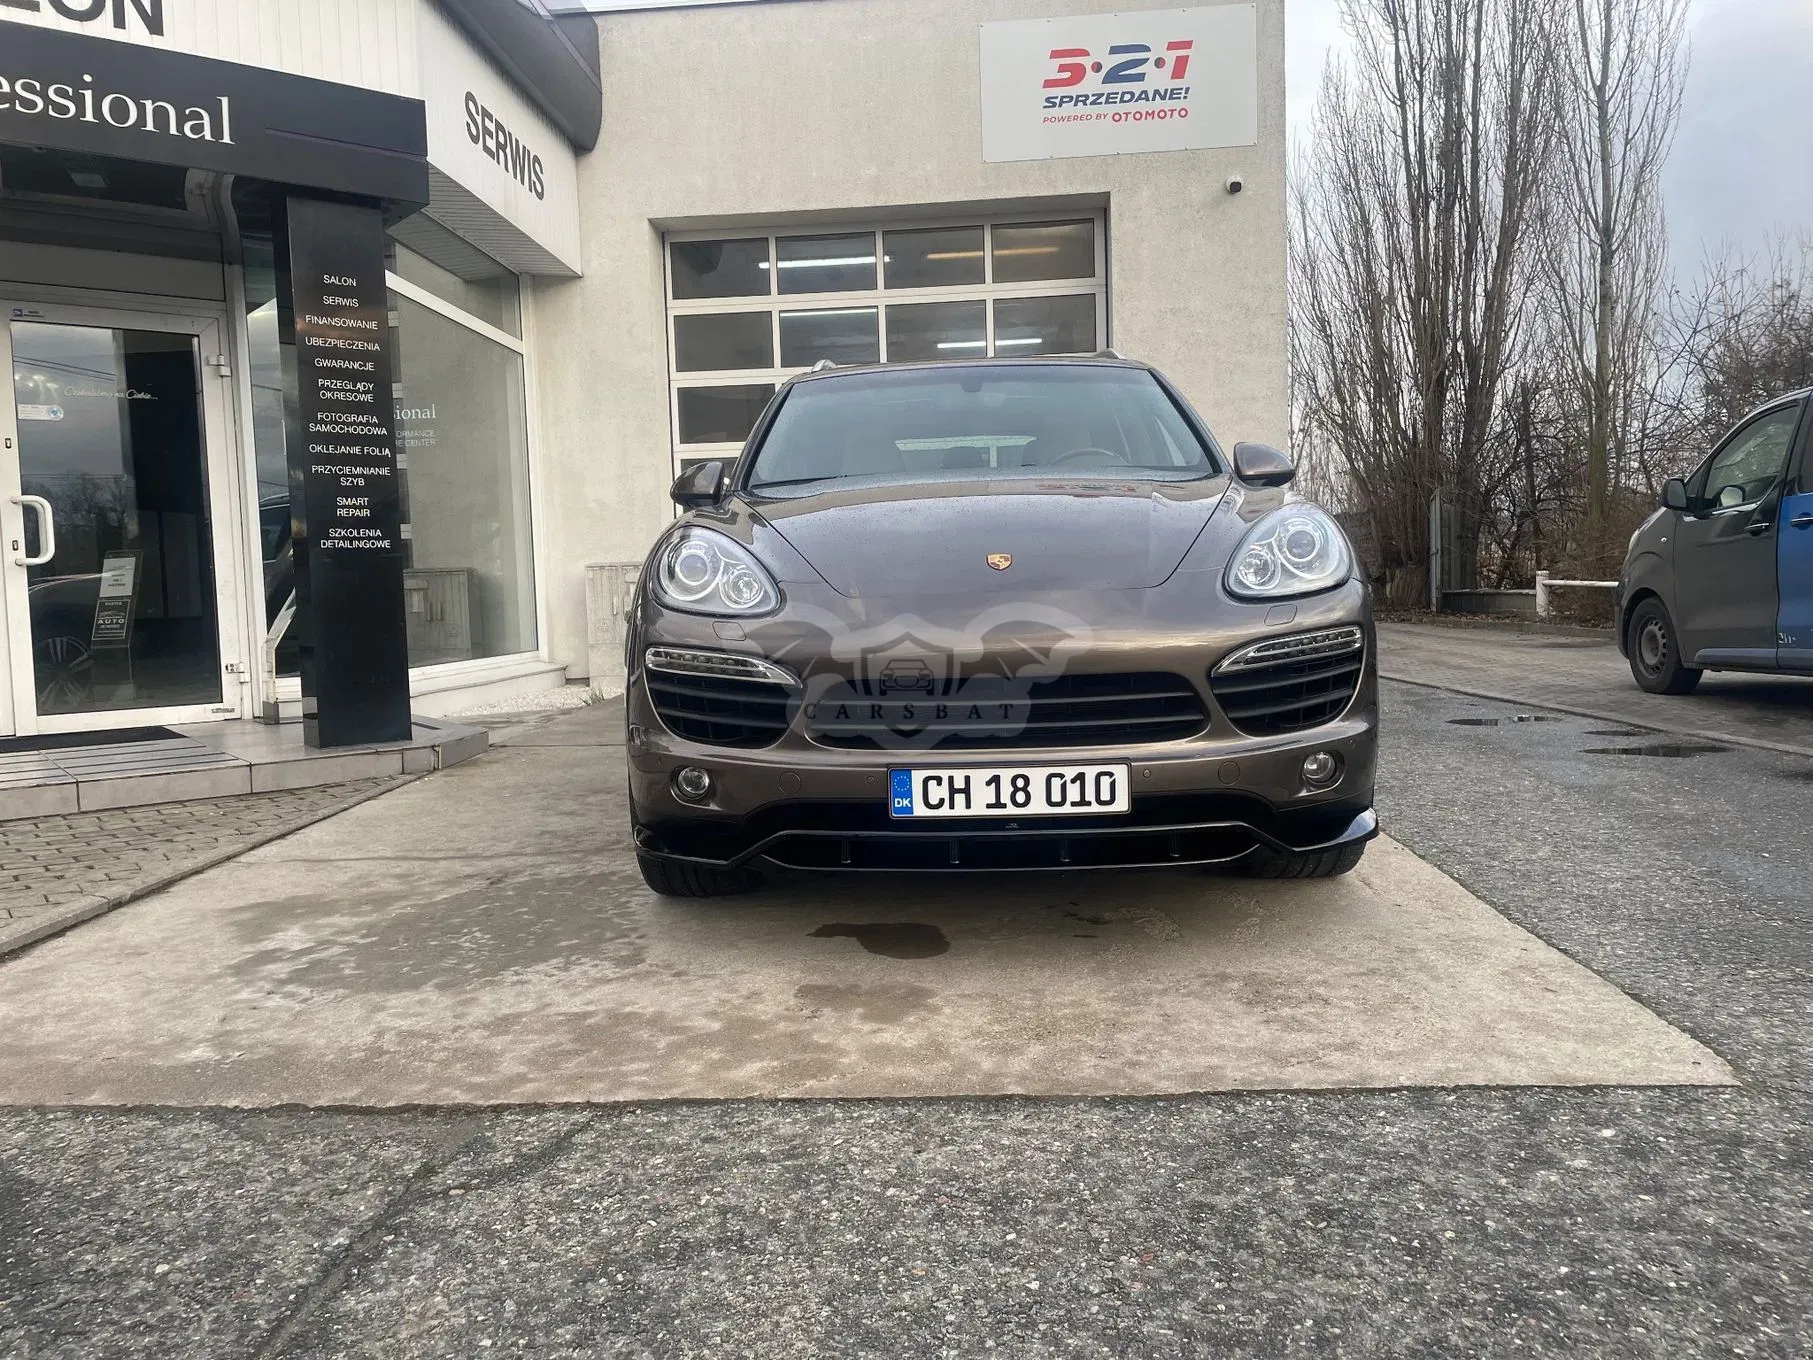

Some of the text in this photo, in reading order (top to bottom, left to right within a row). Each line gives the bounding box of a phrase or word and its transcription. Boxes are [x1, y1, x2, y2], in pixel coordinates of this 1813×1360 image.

[1042, 86, 1191, 109] SPRZEDANE!
[1043, 107, 1189, 124] POWERED BY OTOMOTO
[464, 91, 544, 201] SERWIS
[323, 274, 357, 287] SALON
[322, 295, 359, 308] SERWIS
[305, 314, 378, 330] FINANSOWANIE
[305, 337, 380, 351] UBEZPIECZENIA
[314, 358, 375, 371] GWARANCJE
[318, 378, 374, 392] PRZEGLĄDY
[320, 390, 374, 403] OKRESOWE
[317, 412, 379, 424] FOTOGRAFIA
[309, 423, 388, 436] SAMOCHODOWA
[309, 444, 391, 457] OKLEJANIE FOLIĄ
[311, 465, 391, 476] PRZYCIEMNIANIE
[340, 477, 365, 486] SZYB
[336, 497, 369, 506] SMART
[336, 508, 371, 517] REPAIR
[328, 528, 382, 537] SZKOLENIA
[320, 539, 391, 549] DETAILINGOWE
[922, 770, 1117, 811] CH 18 010
[894, 797, 912, 808] DK
